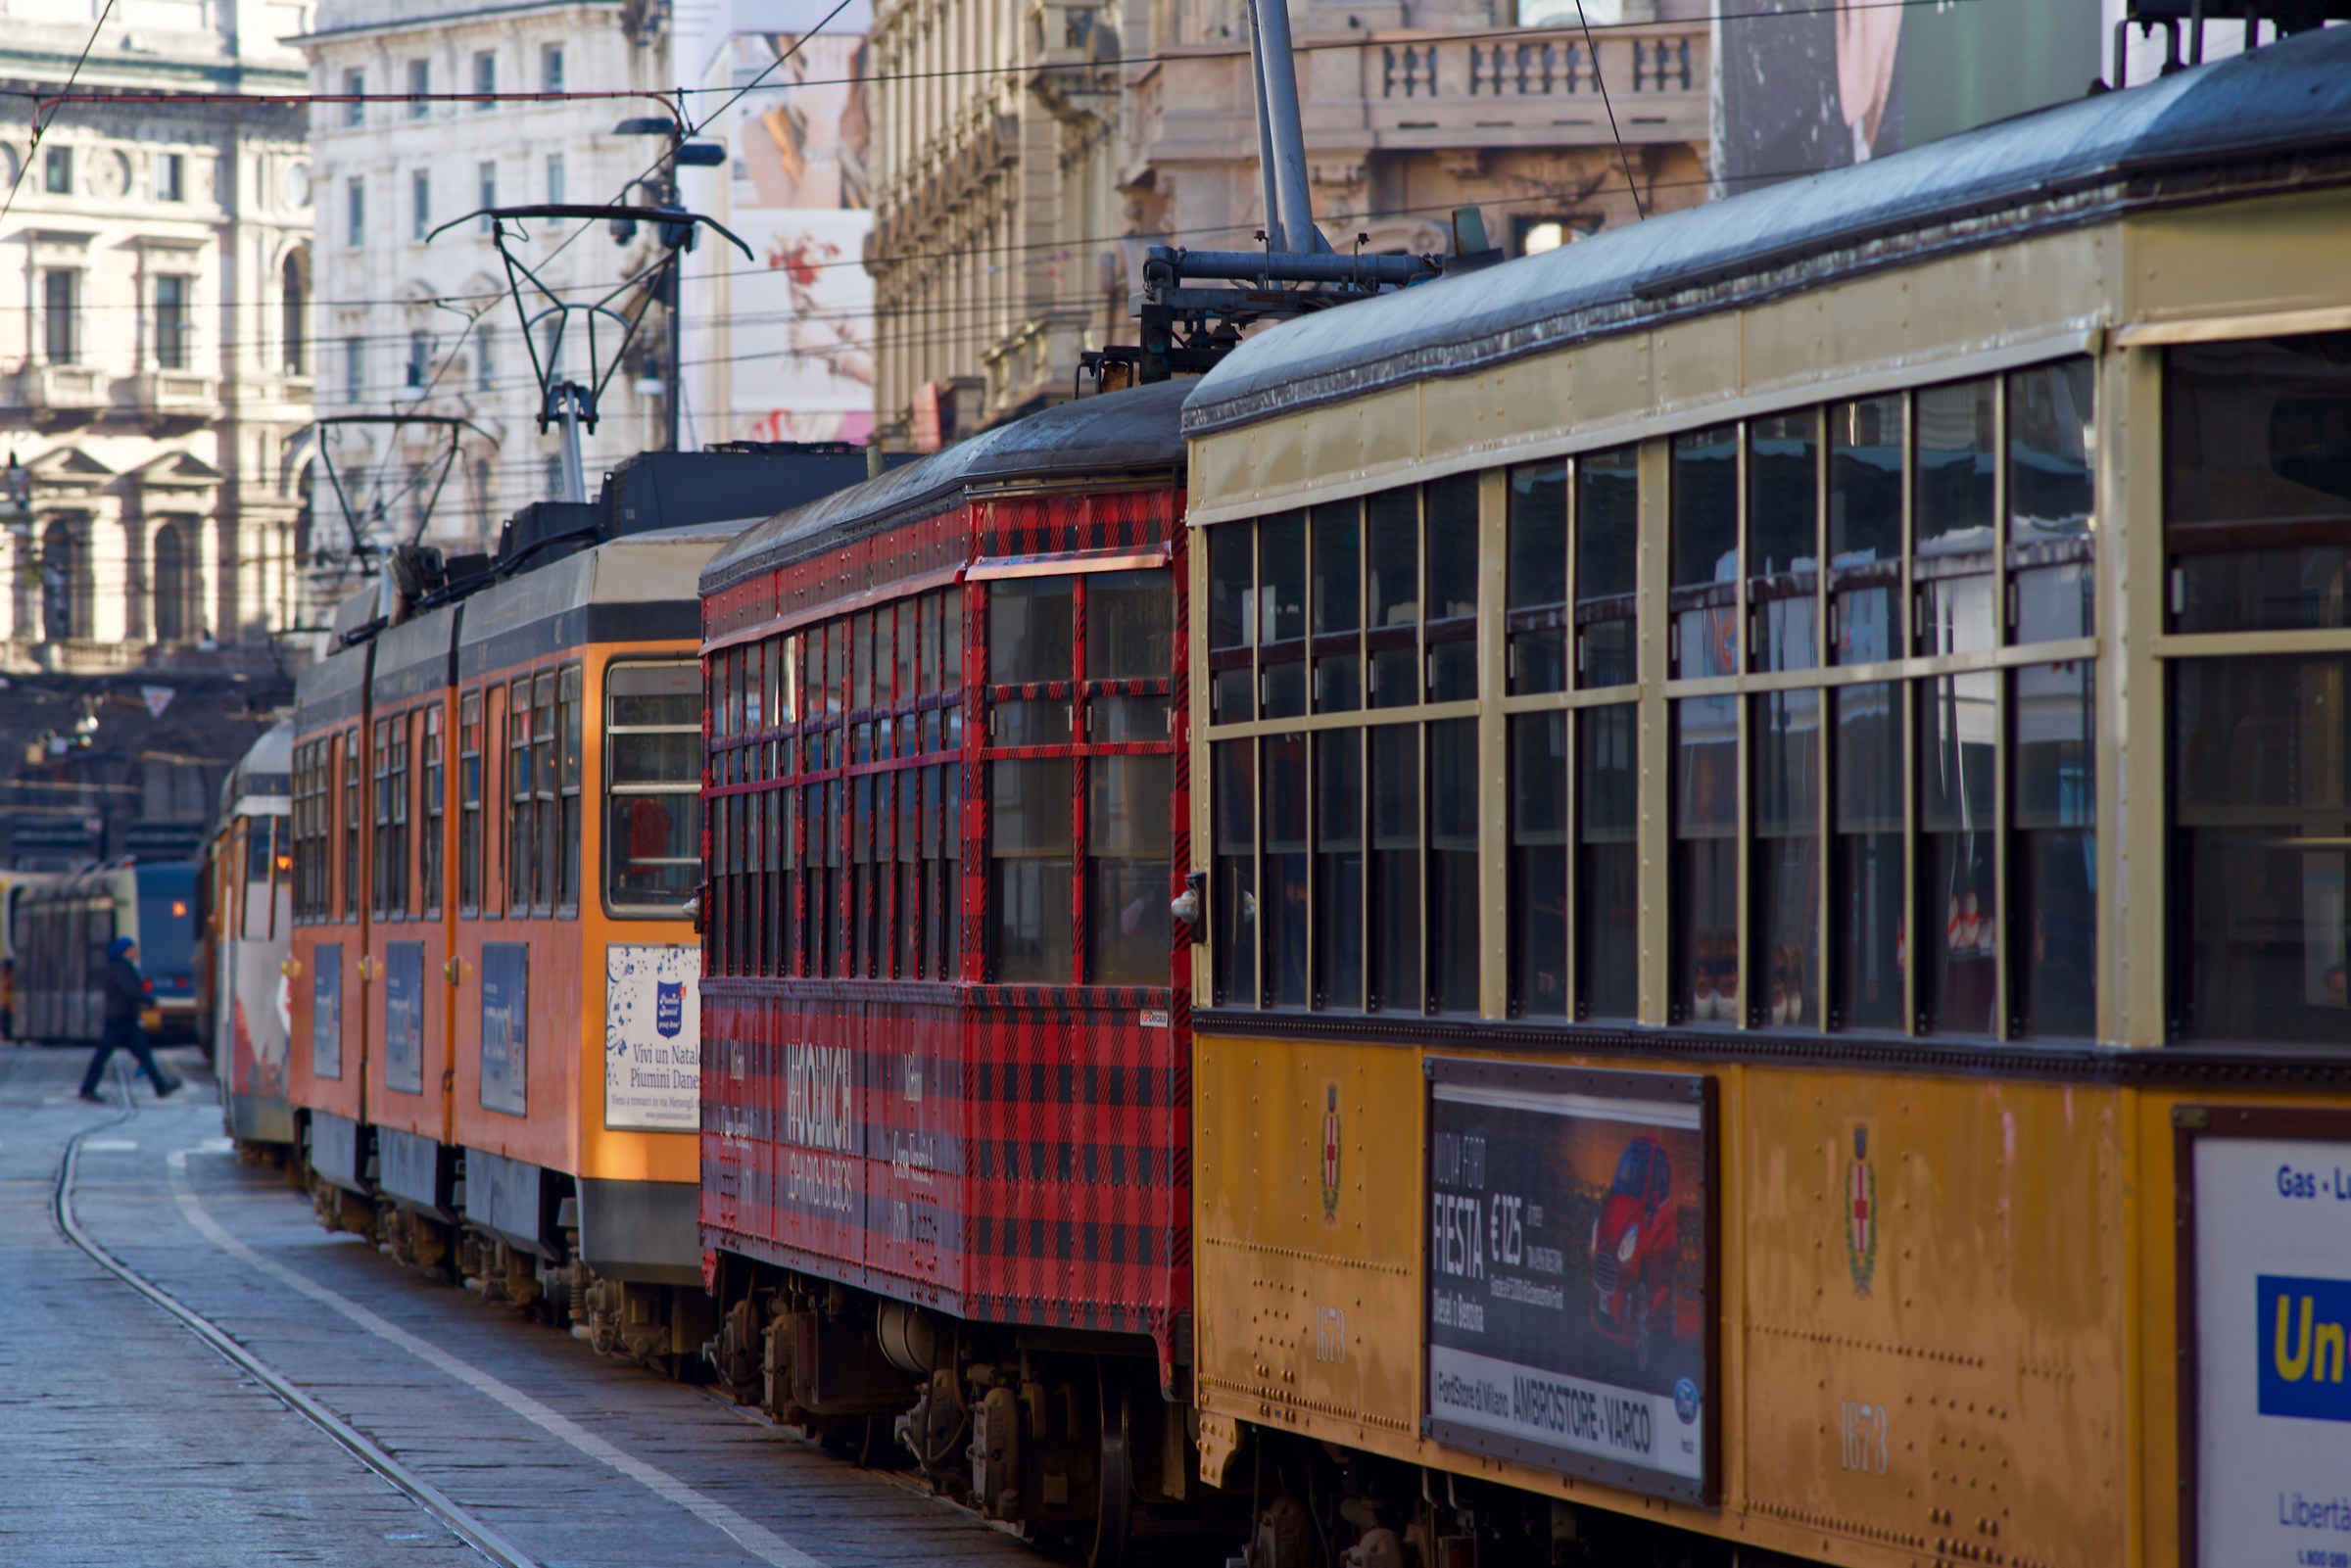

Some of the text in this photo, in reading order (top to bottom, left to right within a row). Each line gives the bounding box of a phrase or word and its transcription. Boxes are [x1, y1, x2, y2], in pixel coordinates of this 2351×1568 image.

[631, 1068, 699, 1089] Piumini Dane
[634, 1043, 698, 1065] Vivi un Natal
[788, 1042, 851, 1151] WOOLRICH
[806, 1155, 823, 1206] RICH
[825, 1158, 831, 1209] &
[1463, 1135, 1486, 1190] FORD
[2278, 1164, 2316, 1199] Gas
[1433, 1191, 1484, 1281] FIESTA
[1433, 1287, 1452, 1325] Diesel
[2275, 1294, 2351, 1385] Un
[1438, 1371, 1474, 1409] FordStore
[1475, 1378, 1482, 1411] di
[1483, 1382, 1509, 1418] Milano
[1513, 1374, 1598, 1440] AMBROSTORE
[1605, 1396, 1651, 1453] VARCO
[1842, 1398, 1888, 1476] 1673
